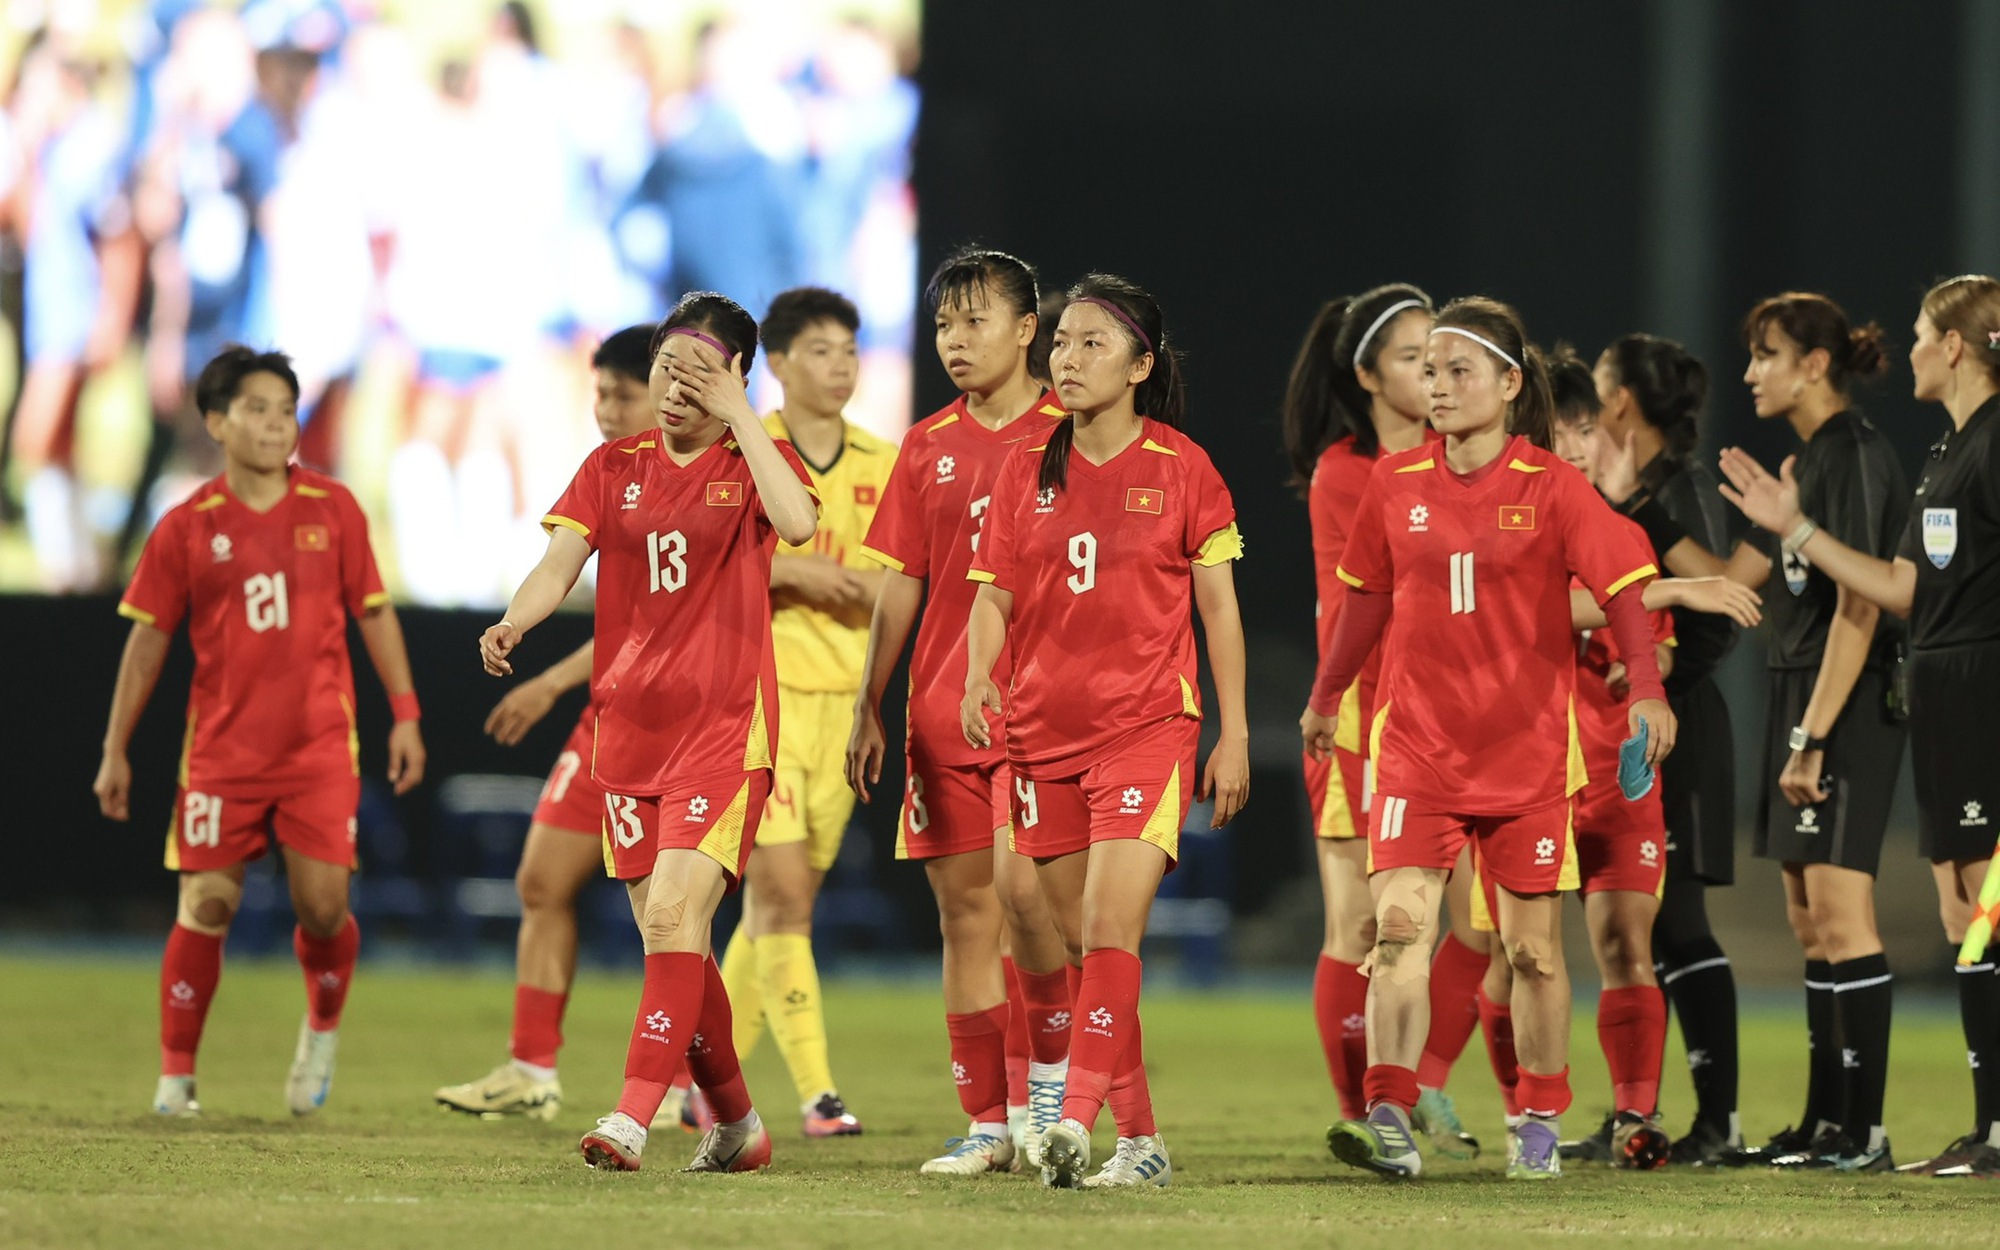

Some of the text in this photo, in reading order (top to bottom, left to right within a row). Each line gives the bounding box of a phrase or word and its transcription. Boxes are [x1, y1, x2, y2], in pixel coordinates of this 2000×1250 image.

[1926, 514, 1952, 527] FIFA
[647, 529, 688, 595] 13
[1066, 531, 1098, 595] 9
[1449, 551, 1476, 615] 11
[243, 571, 289, 632] 21
[184, 791, 223, 848] 21
[605, 791, 645, 850] 13
[1016, 776, 1039, 830] 9
[1380, 796, 1408, 842] 11
